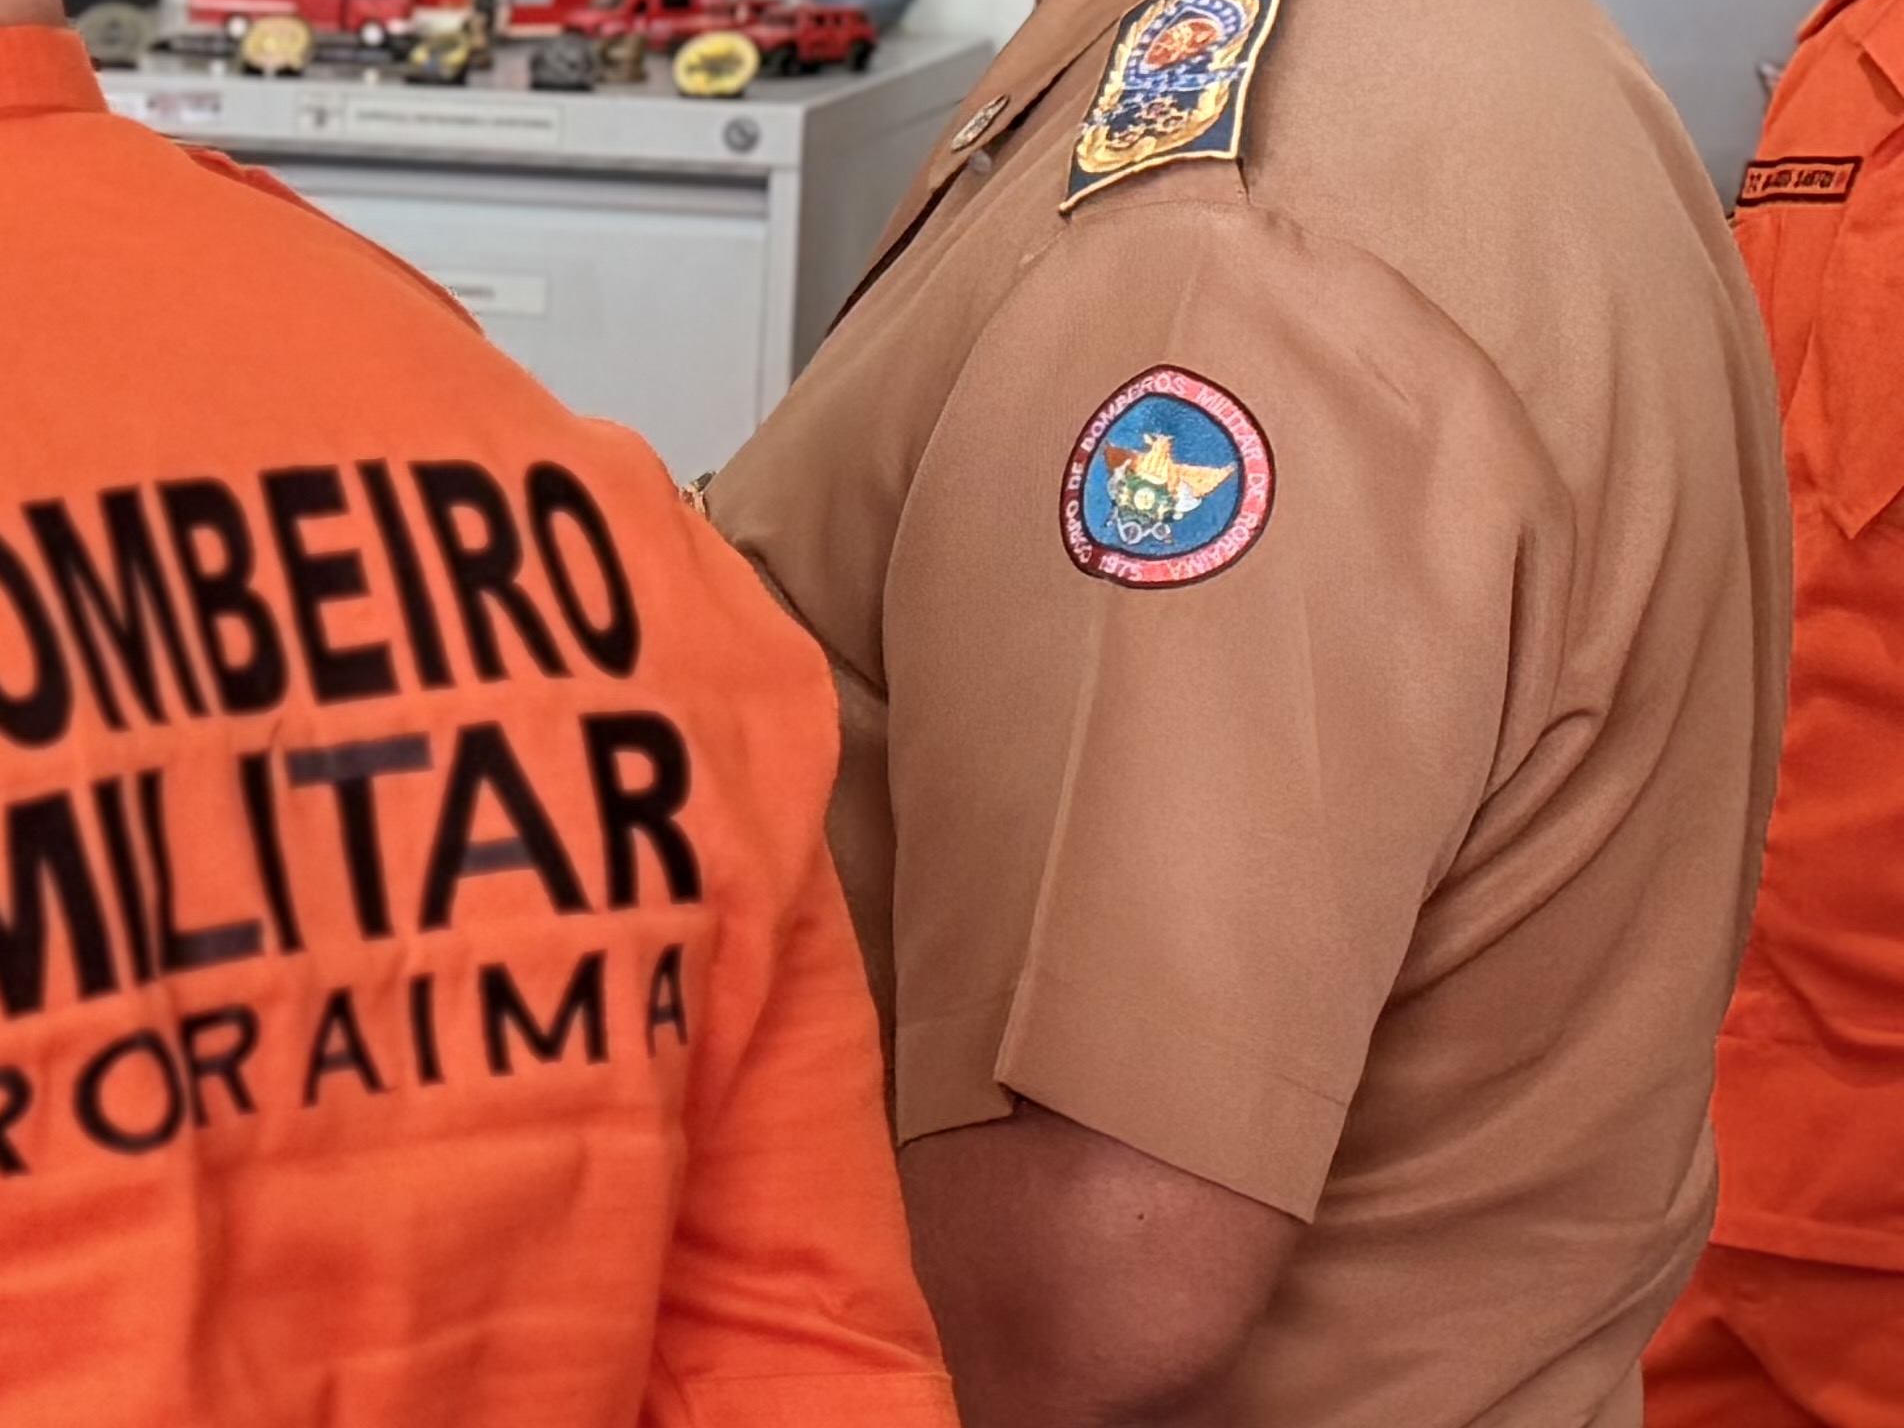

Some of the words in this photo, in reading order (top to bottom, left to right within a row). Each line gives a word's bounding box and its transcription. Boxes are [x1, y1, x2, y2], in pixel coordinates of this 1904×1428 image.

[1194, 385, 1264, 461] MILITAR
[1247, 473, 1266, 500] DE
[1167, 512, 1258, 580] RORAIMA
